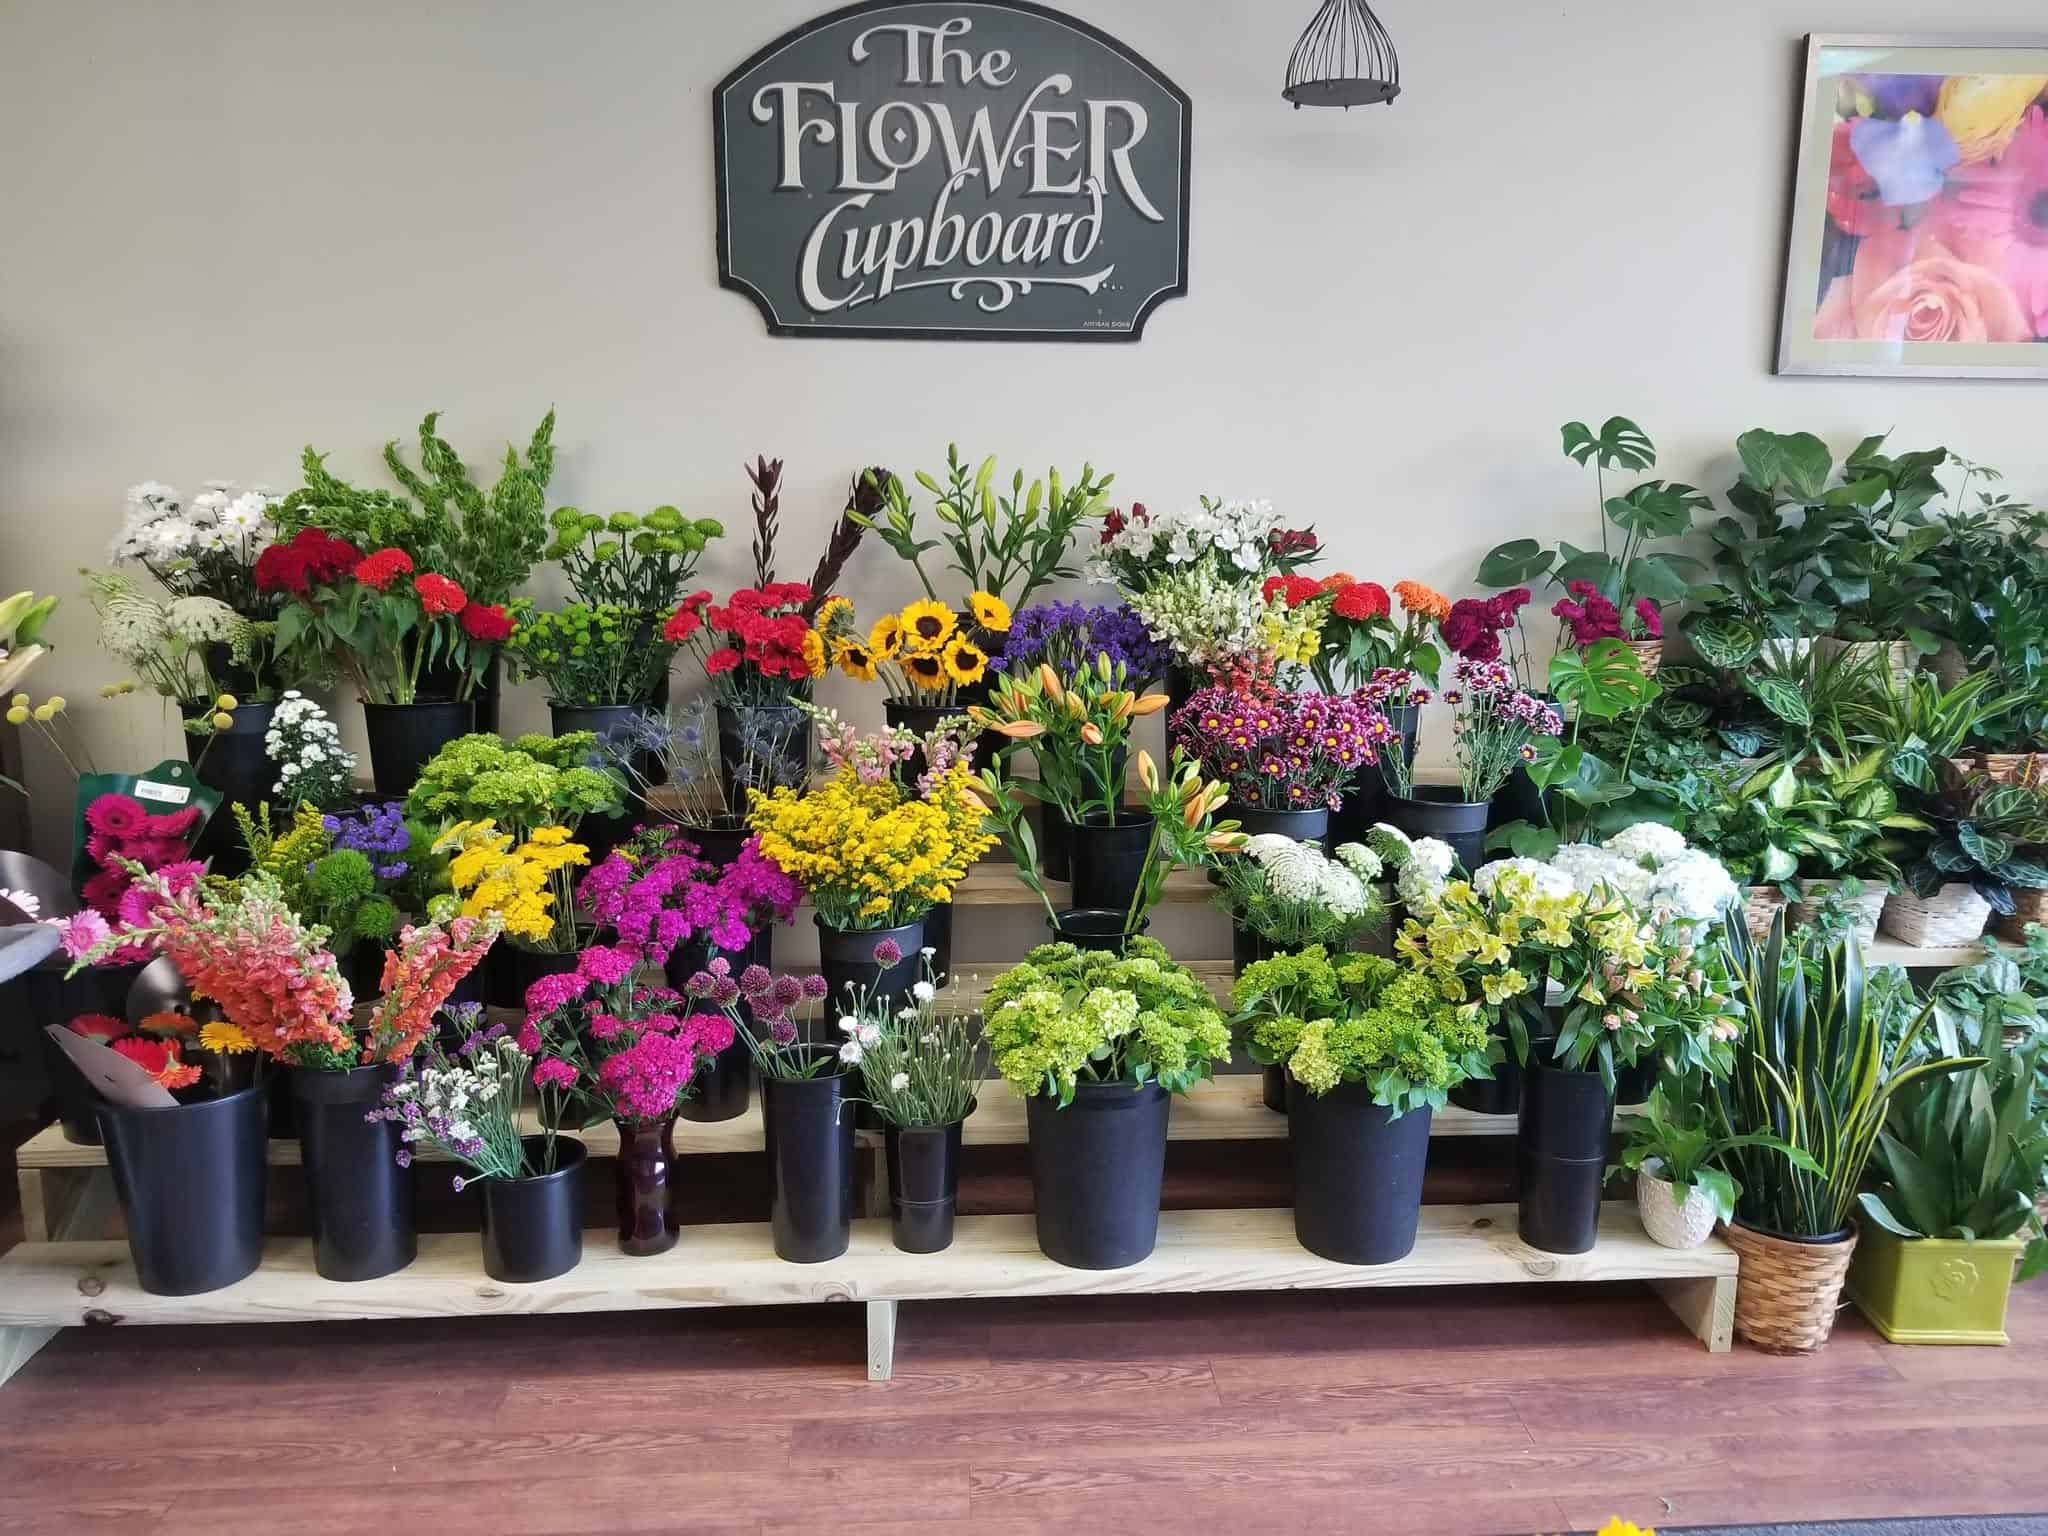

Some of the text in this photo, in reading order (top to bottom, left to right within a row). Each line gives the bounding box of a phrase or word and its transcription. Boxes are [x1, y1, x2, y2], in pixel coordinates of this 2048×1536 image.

[852, 17, 1017, 86] The
[752, 74, 1165, 222] FLOWER
[801, 167, 1104, 312] Cupboard
